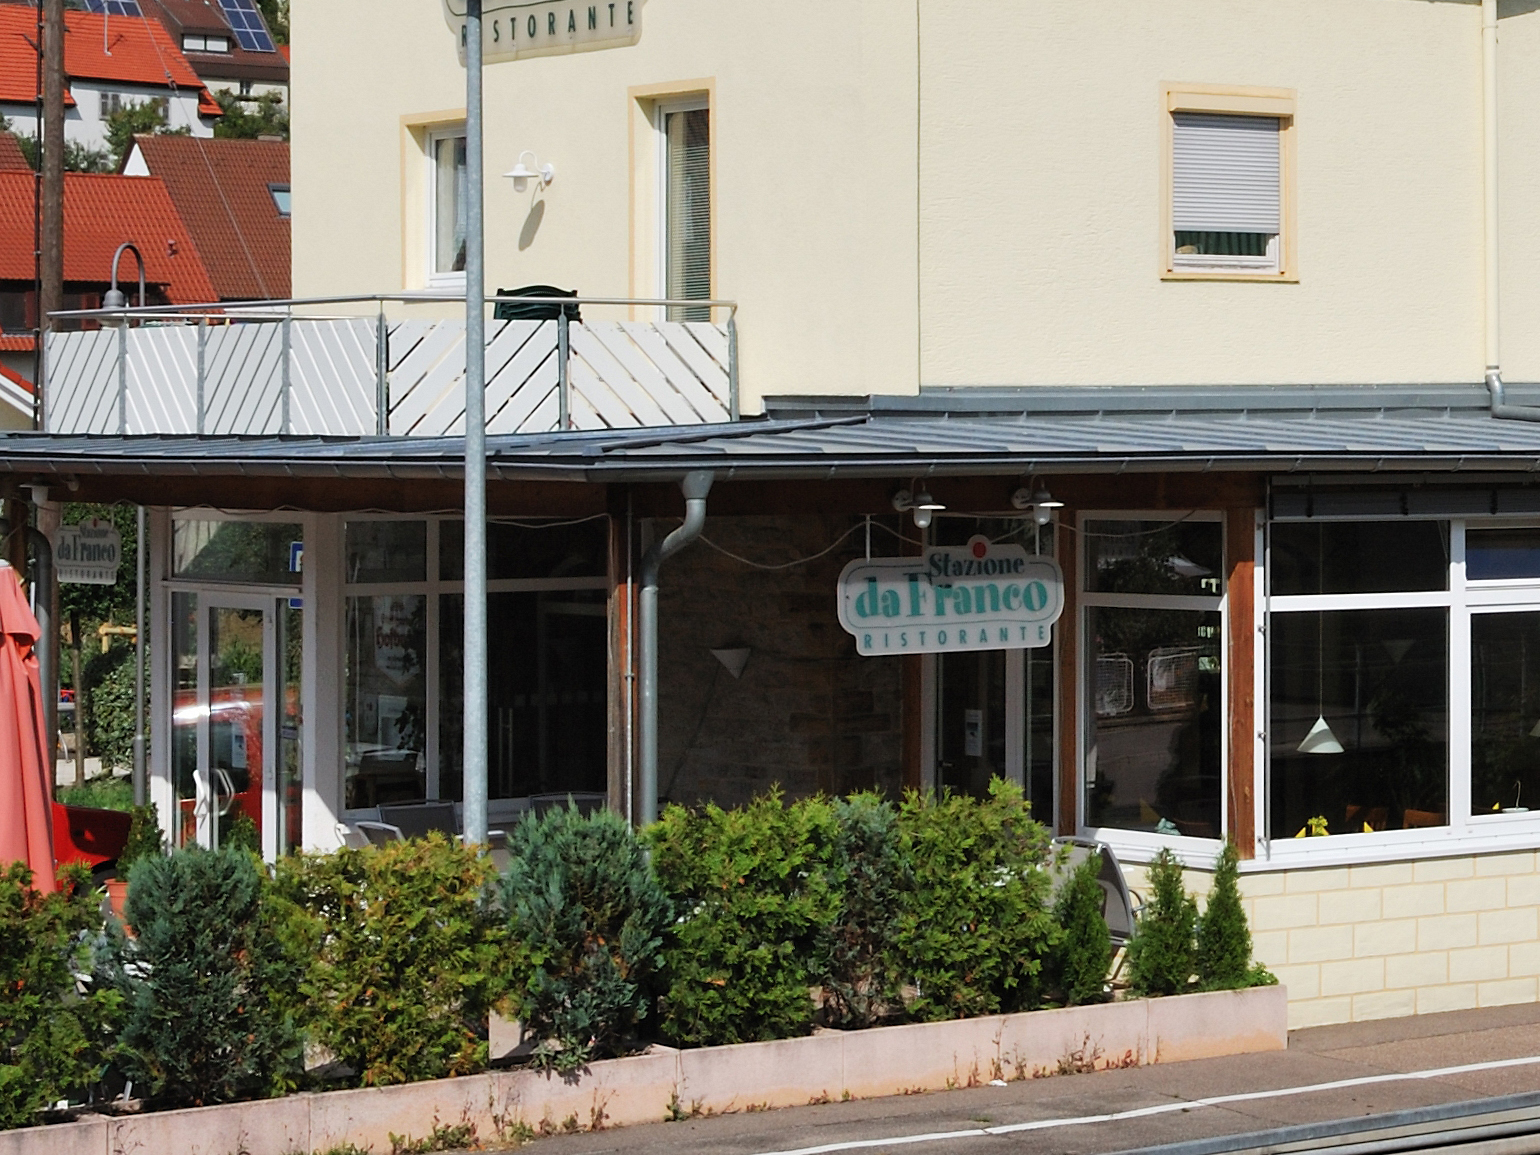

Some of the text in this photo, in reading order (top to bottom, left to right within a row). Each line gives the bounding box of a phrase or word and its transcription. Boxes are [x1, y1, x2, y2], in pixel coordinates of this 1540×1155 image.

[461, 0, 634, 47] RSTORANTE
[929, 552, 1026, 578] Stazione
[855, 572, 1048, 619] da Franco
[863, 625, 1046, 649] RISTORANTE
